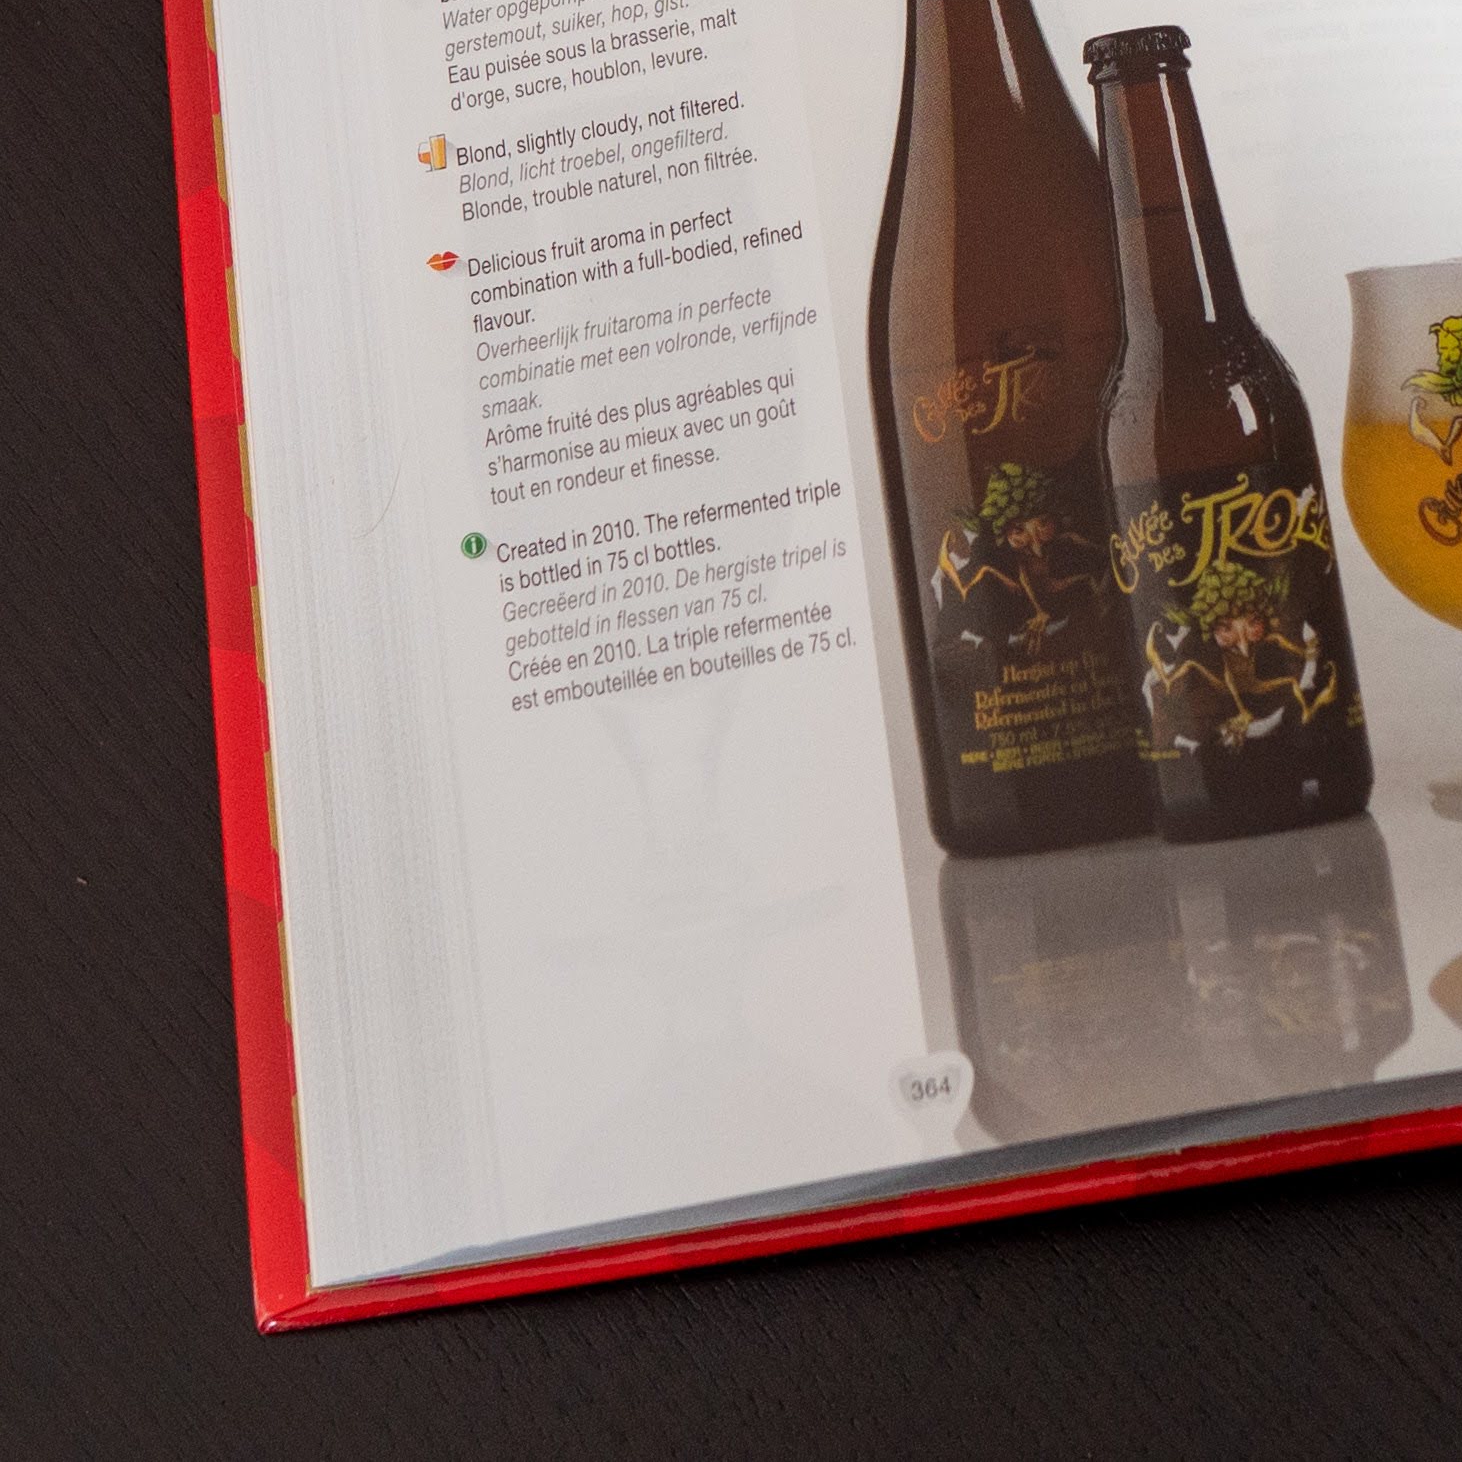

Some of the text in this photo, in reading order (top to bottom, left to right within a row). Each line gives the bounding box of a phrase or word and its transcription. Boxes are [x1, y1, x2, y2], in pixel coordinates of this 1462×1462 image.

[457, 91, 744, 167] Blond, slightly cloudy, not filtered.
[467, 207, 733, 277] Delicious fruit aroma in perfect
[471, 220, 803, 305] combination with a full-bodied, refined
[473, 309, 535, 333] flavour.
[485, 368, 794, 447] Arôme fruité des plus agréables qui
[496, 479, 840, 563] Created in 2010. The refermented triple
[500, 537, 720, 592] is bottled in 75 cl bottles.
[909, 1074, 953, 1101] 364
